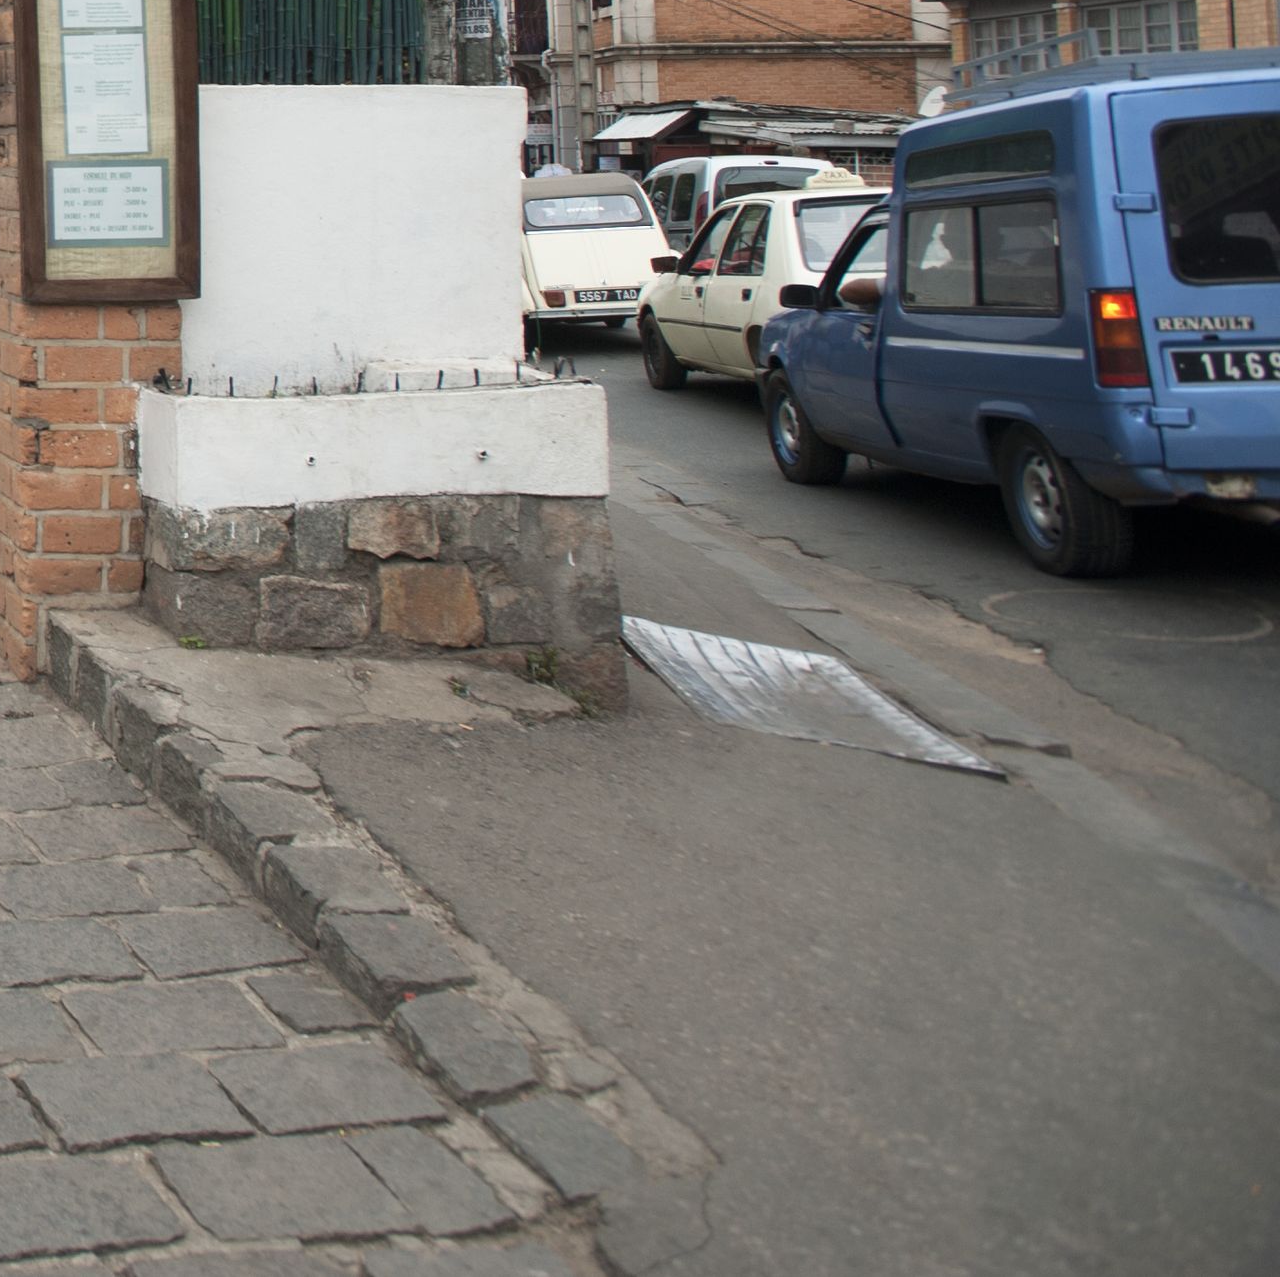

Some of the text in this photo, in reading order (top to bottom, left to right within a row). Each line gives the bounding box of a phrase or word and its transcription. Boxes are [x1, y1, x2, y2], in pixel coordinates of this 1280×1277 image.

[579, 289, 638, 302] 5567 TAD
[1157, 316, 1252, 331] RENAULT
[1200, 352, 1280, 381] 1469
